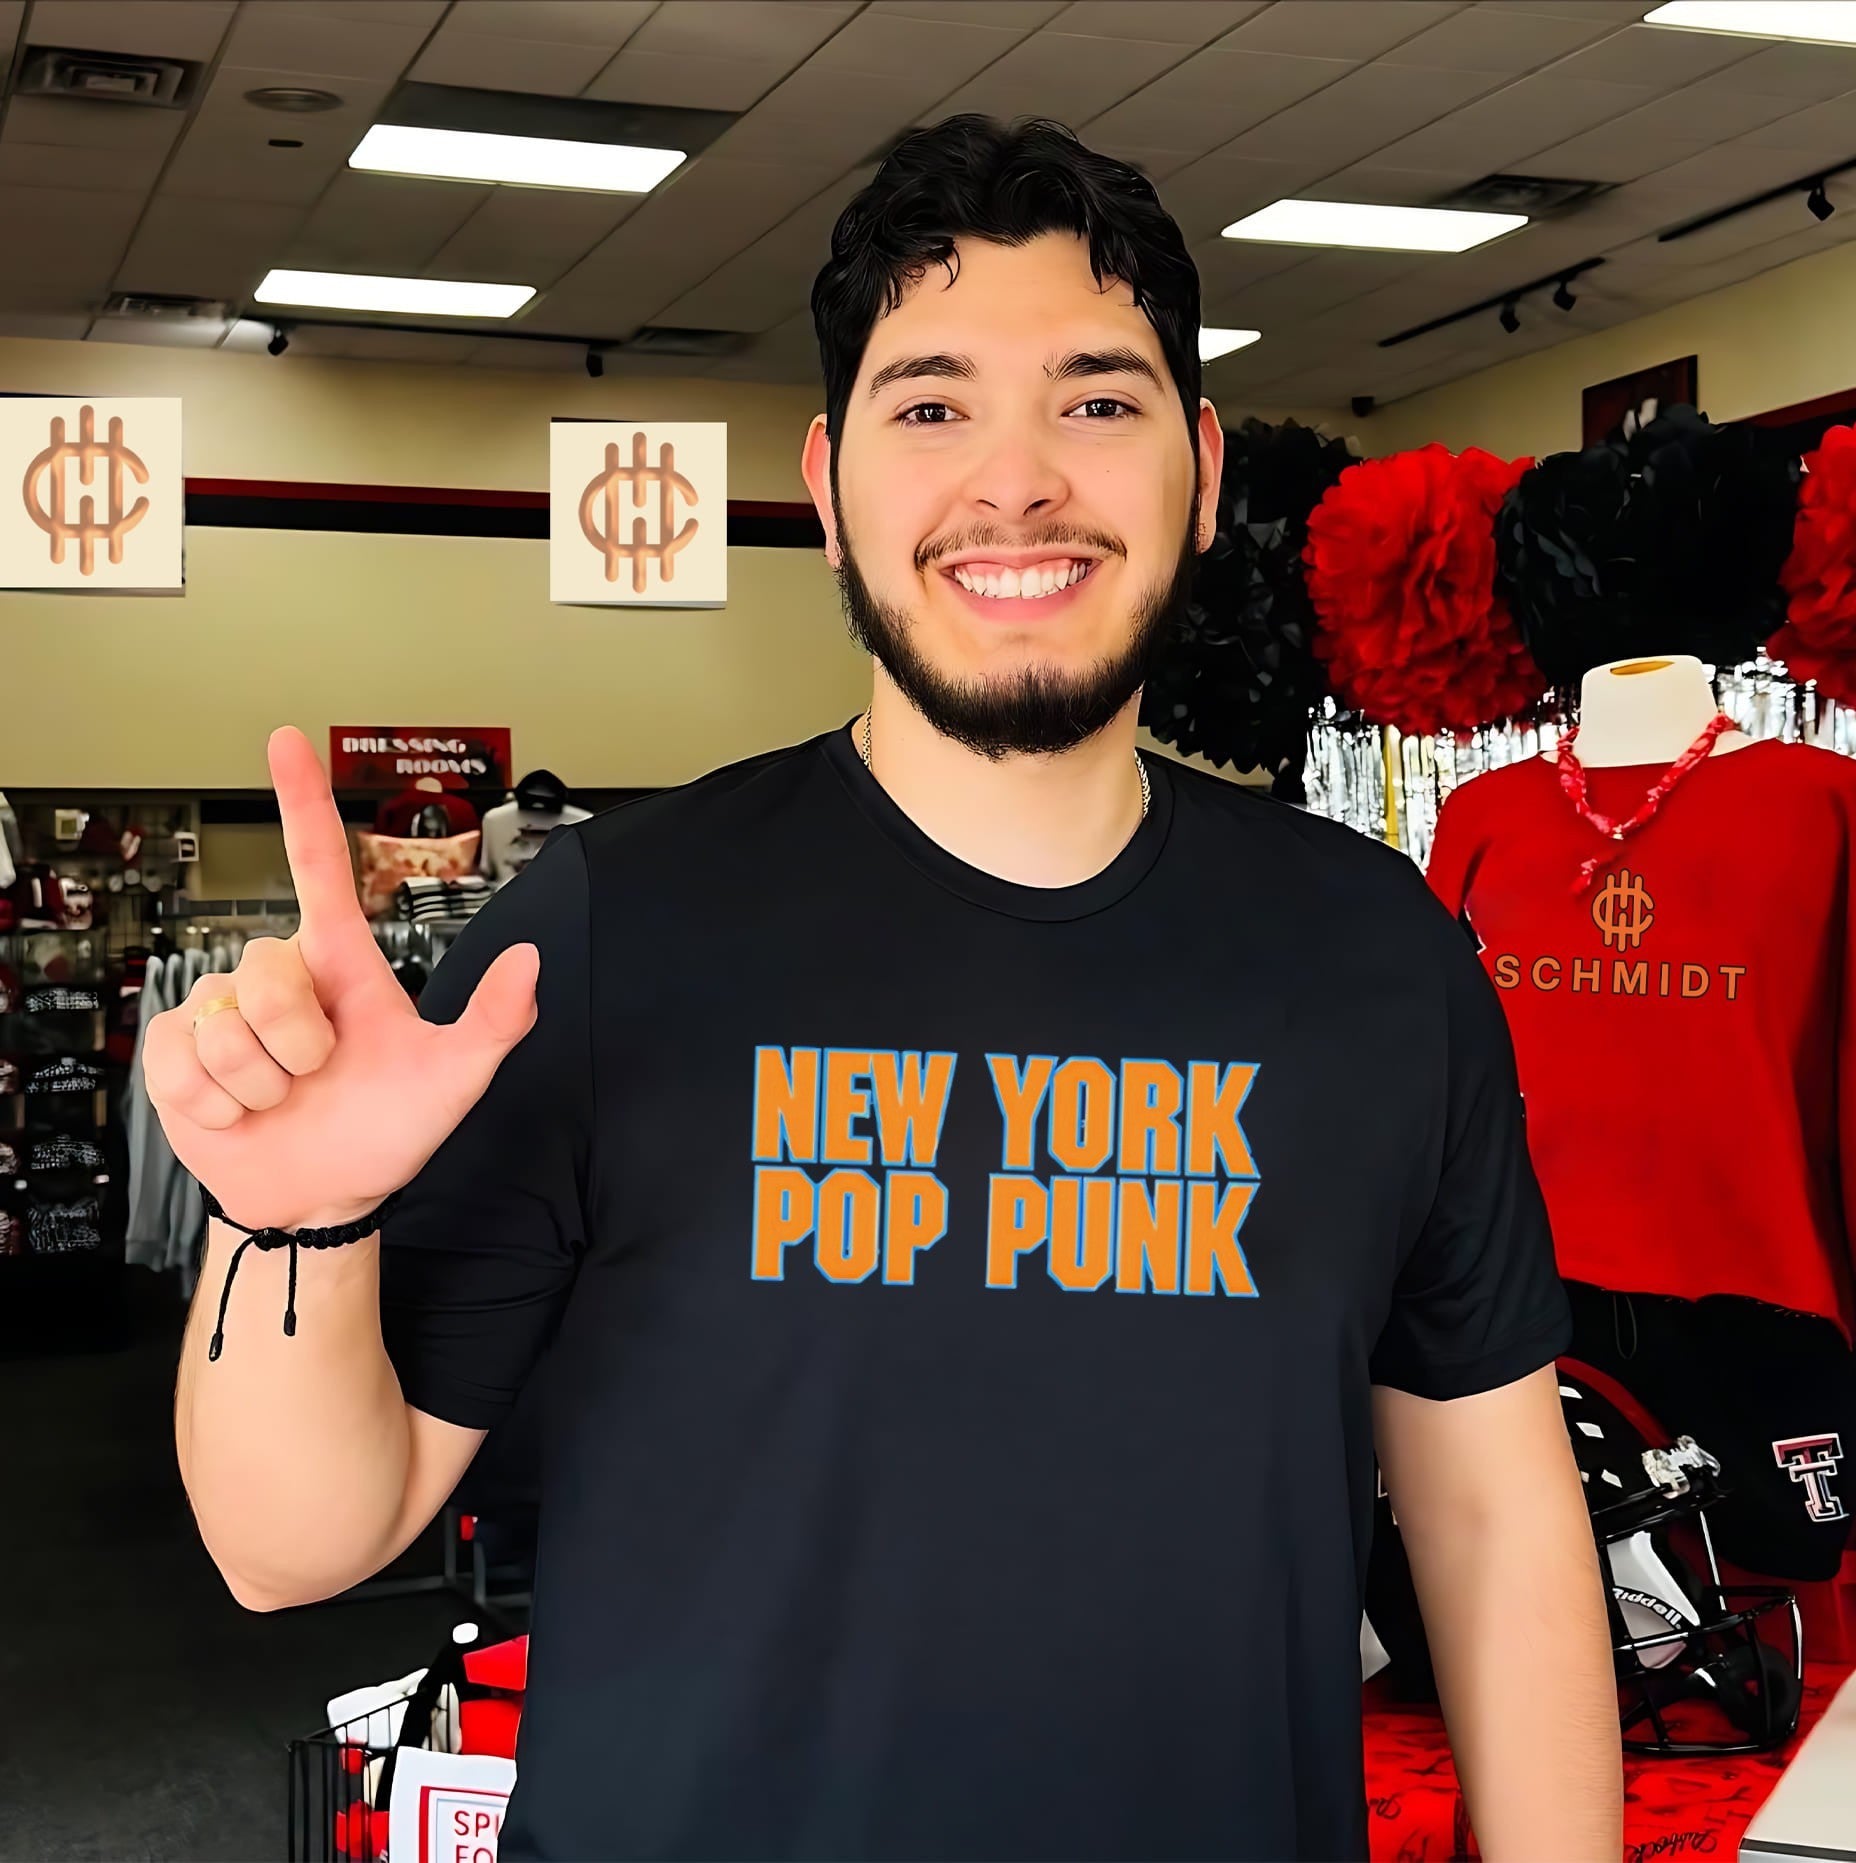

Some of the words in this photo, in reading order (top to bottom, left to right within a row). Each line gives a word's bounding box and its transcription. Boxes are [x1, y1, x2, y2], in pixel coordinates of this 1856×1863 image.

[396, 758, 487, 775] ROOMS
[1494, 954, 1747, 1000] SCHMIDT
[752, 1045, 957, 1168] NEW
[985, 1053, 1261, 1179] YORK
[751, 1165, 949, 1285] POP
[985, 1173, 1261, 1298] PUNK
